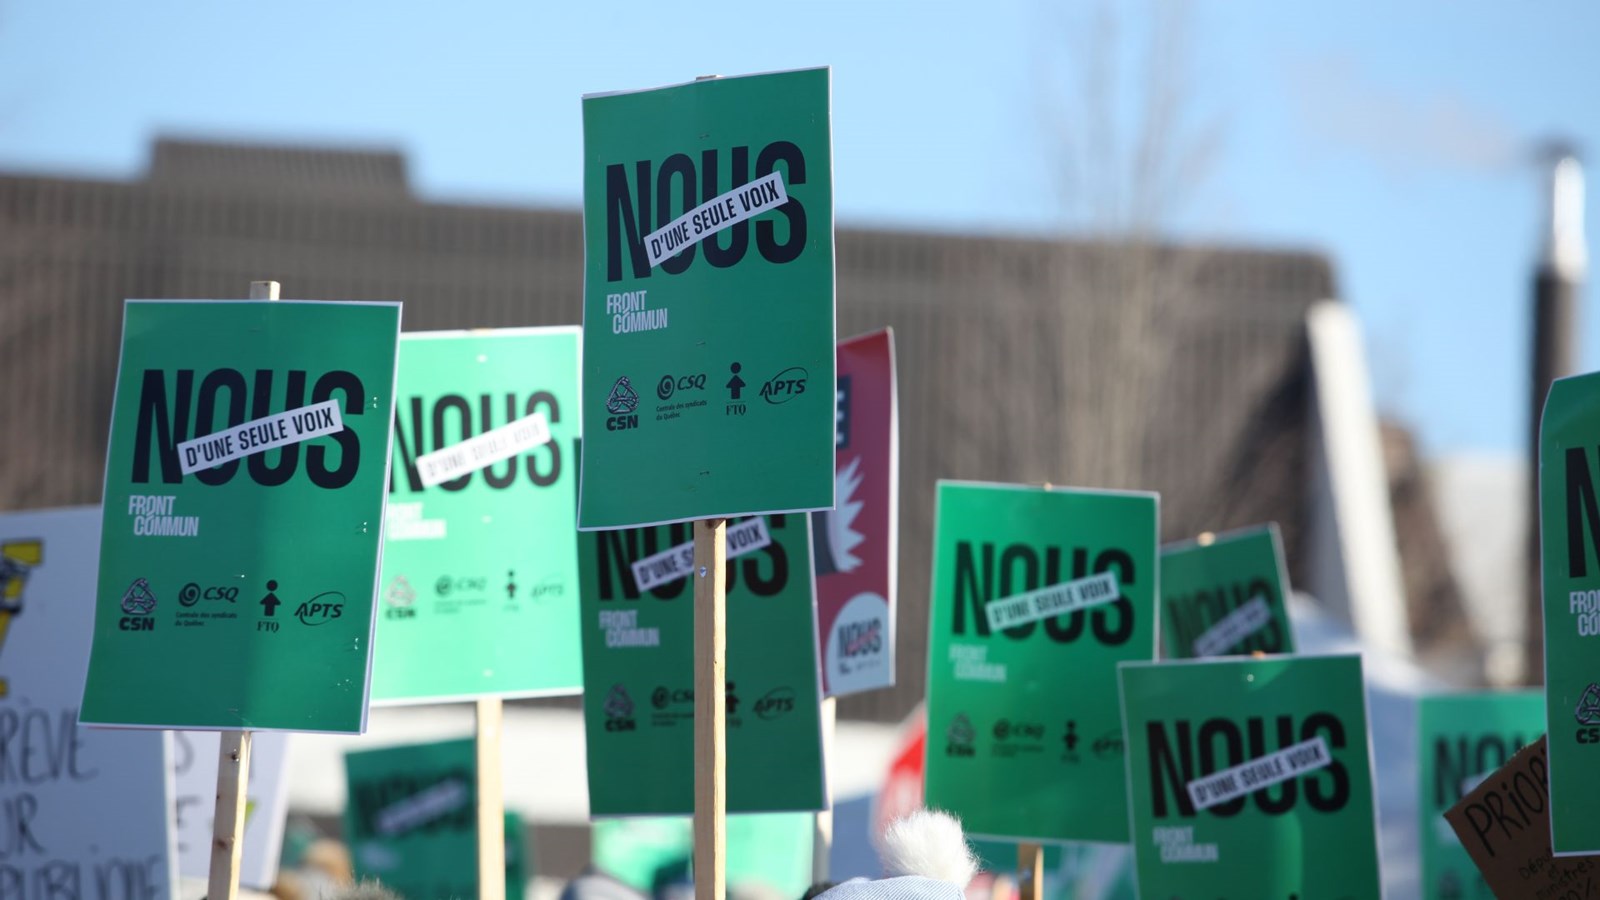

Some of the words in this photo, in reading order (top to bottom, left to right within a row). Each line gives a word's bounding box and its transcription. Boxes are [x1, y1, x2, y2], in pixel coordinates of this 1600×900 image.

[607, 141, 807, 282] NOUS
[651, 221, 691, 259] D'UNE
[692, 198, 737, 235] SEULE
[739, 180, 780, 212] VOIX
[606, 290, 647, 314] FRONT
[612, 308, 668, 335] COMMUN
[677, 374, 706, 391] CSQ
[759, 378, 808, 397] APTS
[726, 404, 747, 416] FTQ
[131, 368, 365, 489] NOUS
[606, 414, 639, 431] CSN
[185, 435, 234, 468] D'UNE
[238, 419, 288, 456] SEULE
[291, 407, 335, 435] VOIX
[128, 495, 176, 516] FRONT
[133, 515, 200, 537] COMMUN
[203, 586, 240, 604] CSQ
[952, 541, 1135, 647] NOUS
[294, 602, 344, 619] APTS
[119, 616, 155, 631] CSN
[257, 620, 280, 634] FTQ
[1147, 711, 1350, 819] NOUS
